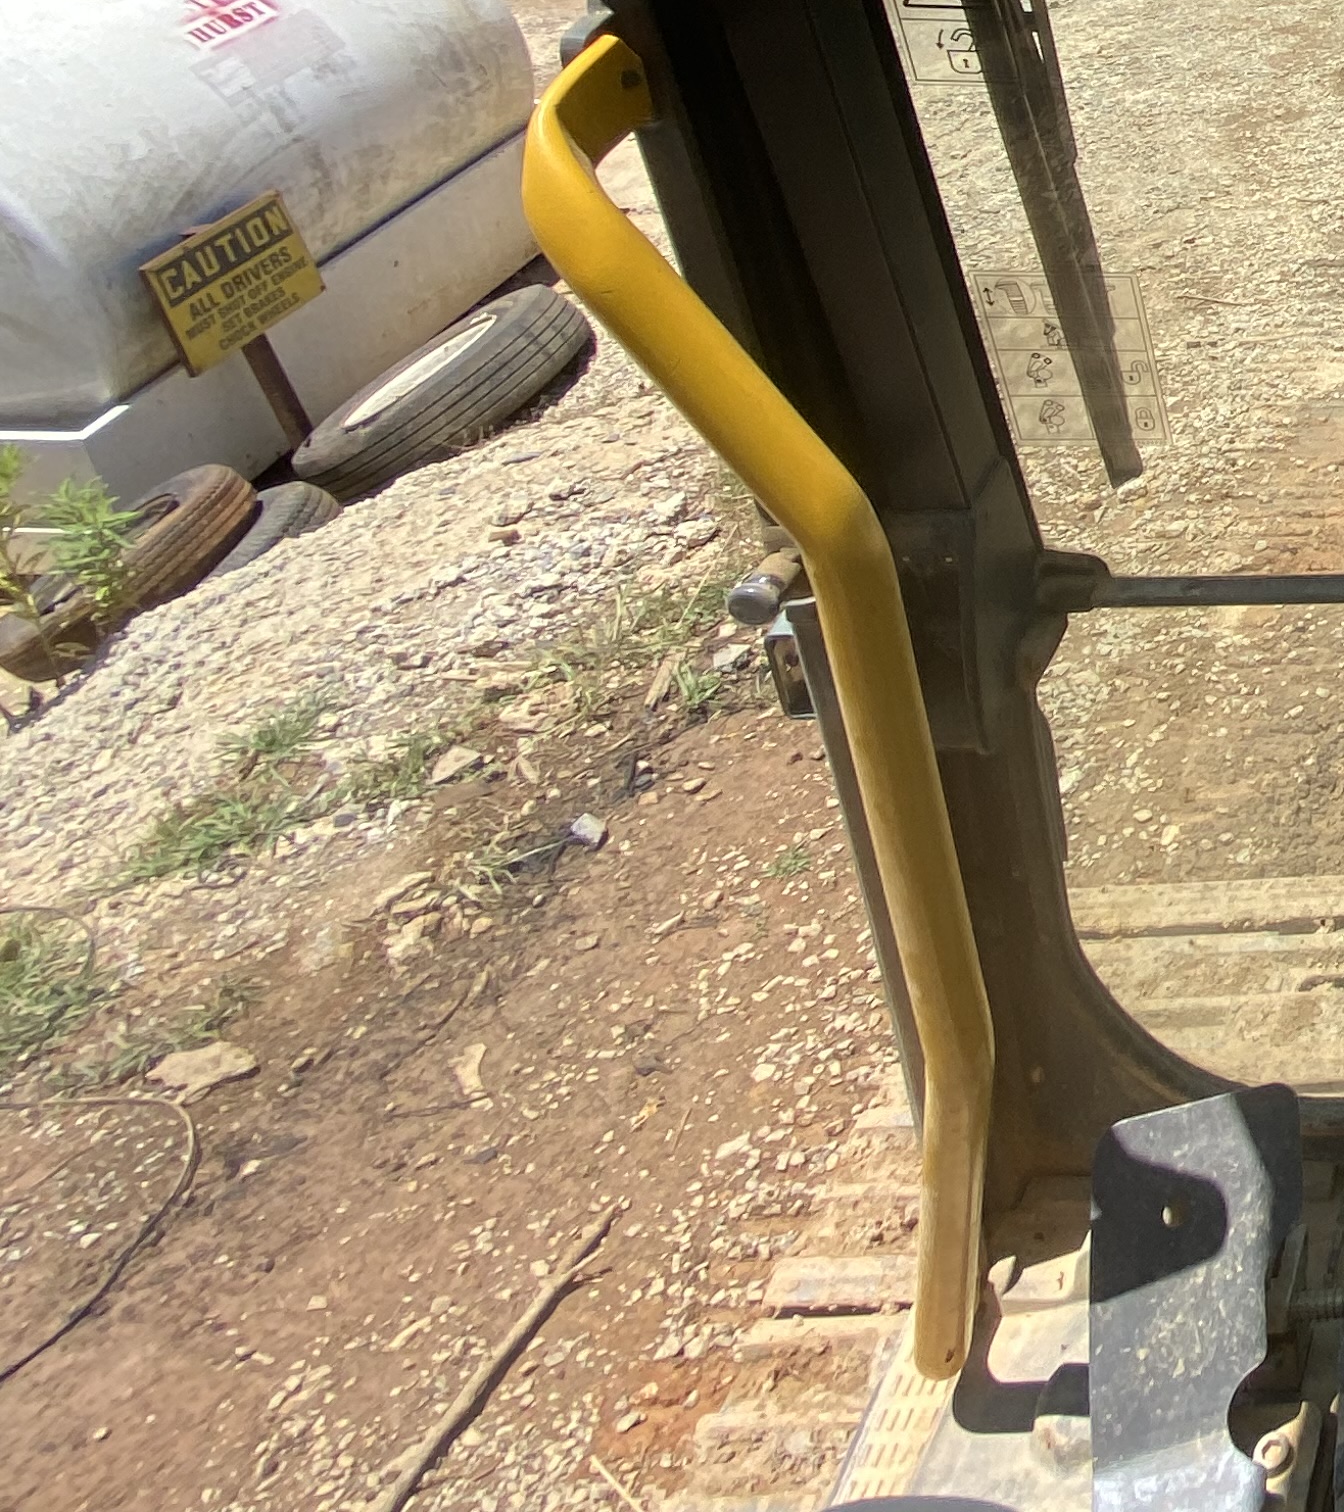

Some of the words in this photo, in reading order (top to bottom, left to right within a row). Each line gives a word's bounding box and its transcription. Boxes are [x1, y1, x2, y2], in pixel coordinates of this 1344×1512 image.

[160, 205, 289, 300] CAUTION
[190, 292, 220, 322] ALL
[221, 246, 292, 299] DRIVERS
